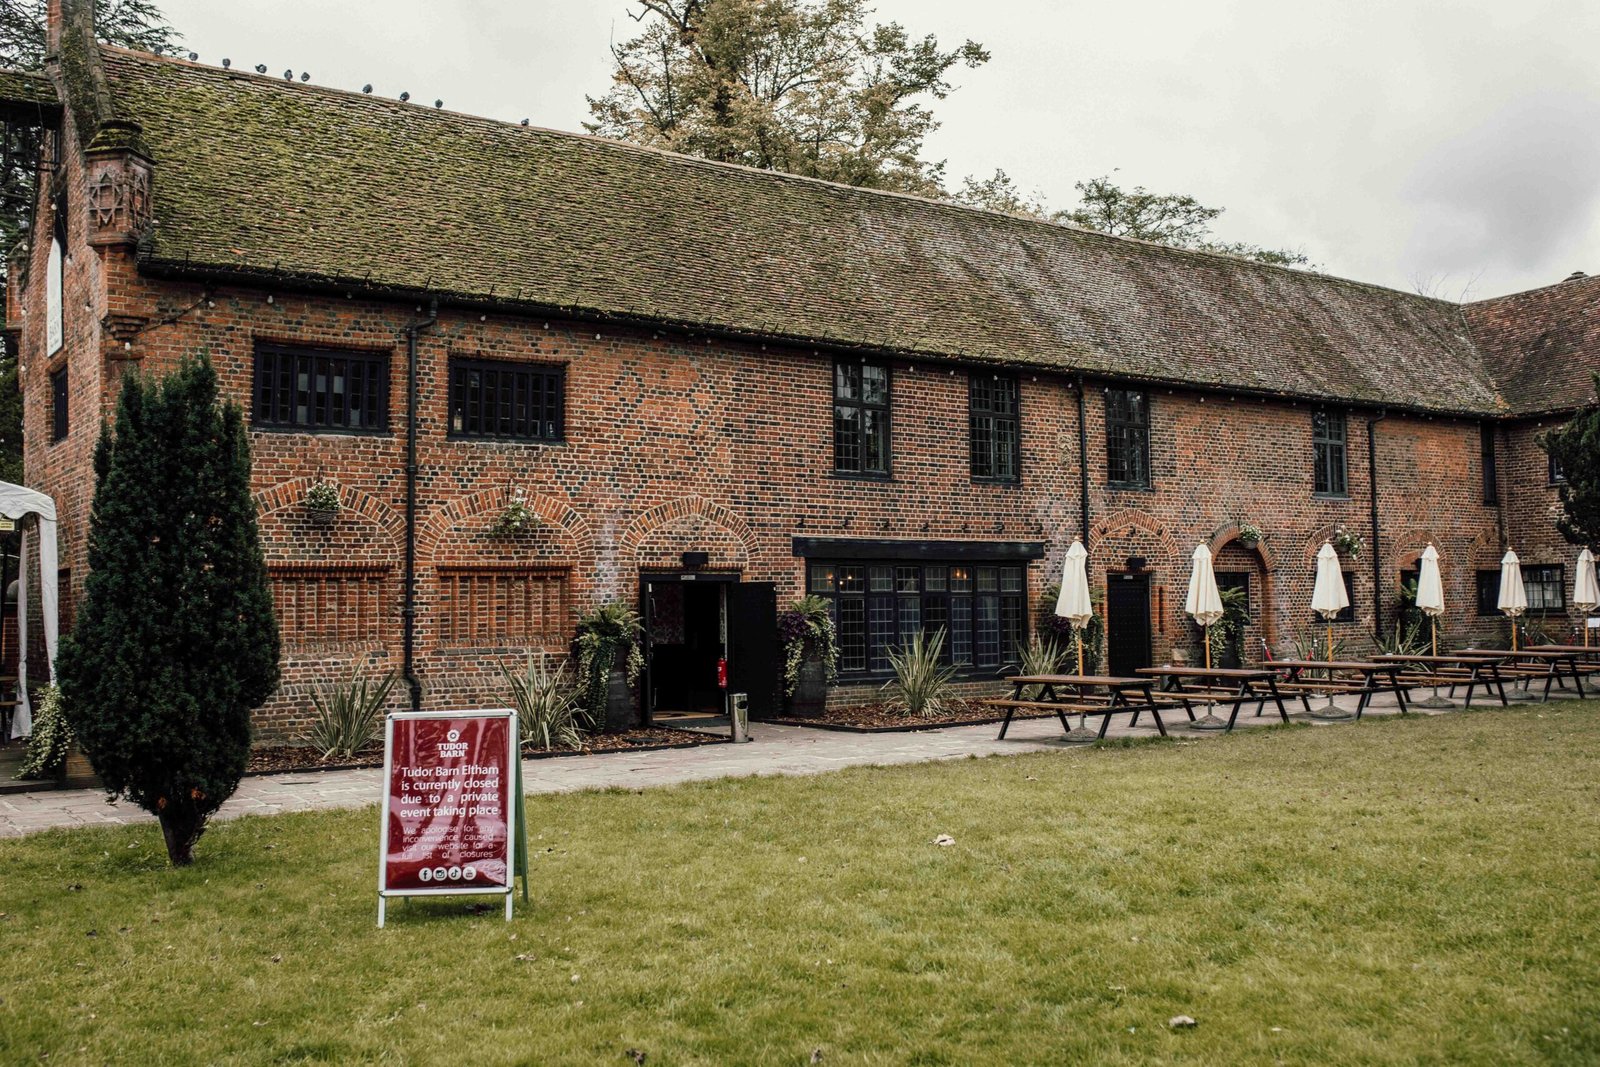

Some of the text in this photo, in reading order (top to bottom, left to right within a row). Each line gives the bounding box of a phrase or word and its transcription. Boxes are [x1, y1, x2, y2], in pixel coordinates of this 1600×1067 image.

[437, 742, 468, 751] TUDOR
[440, 750, 465, 758] BARN
[401, 764, 499, 778] Tudor Barn Eltham
[401, 777, 499, 791] is currently closed
[400, 792, 499, 804] due to a private
[400, 805, 499, 817] event taking place
[464, 824, 474, 832] for
[464, 833, 494, 841] caused
[472, 841, 484, 849] for
[441, 850, 451, 859] of
[459, 850, 494, 858] closures
